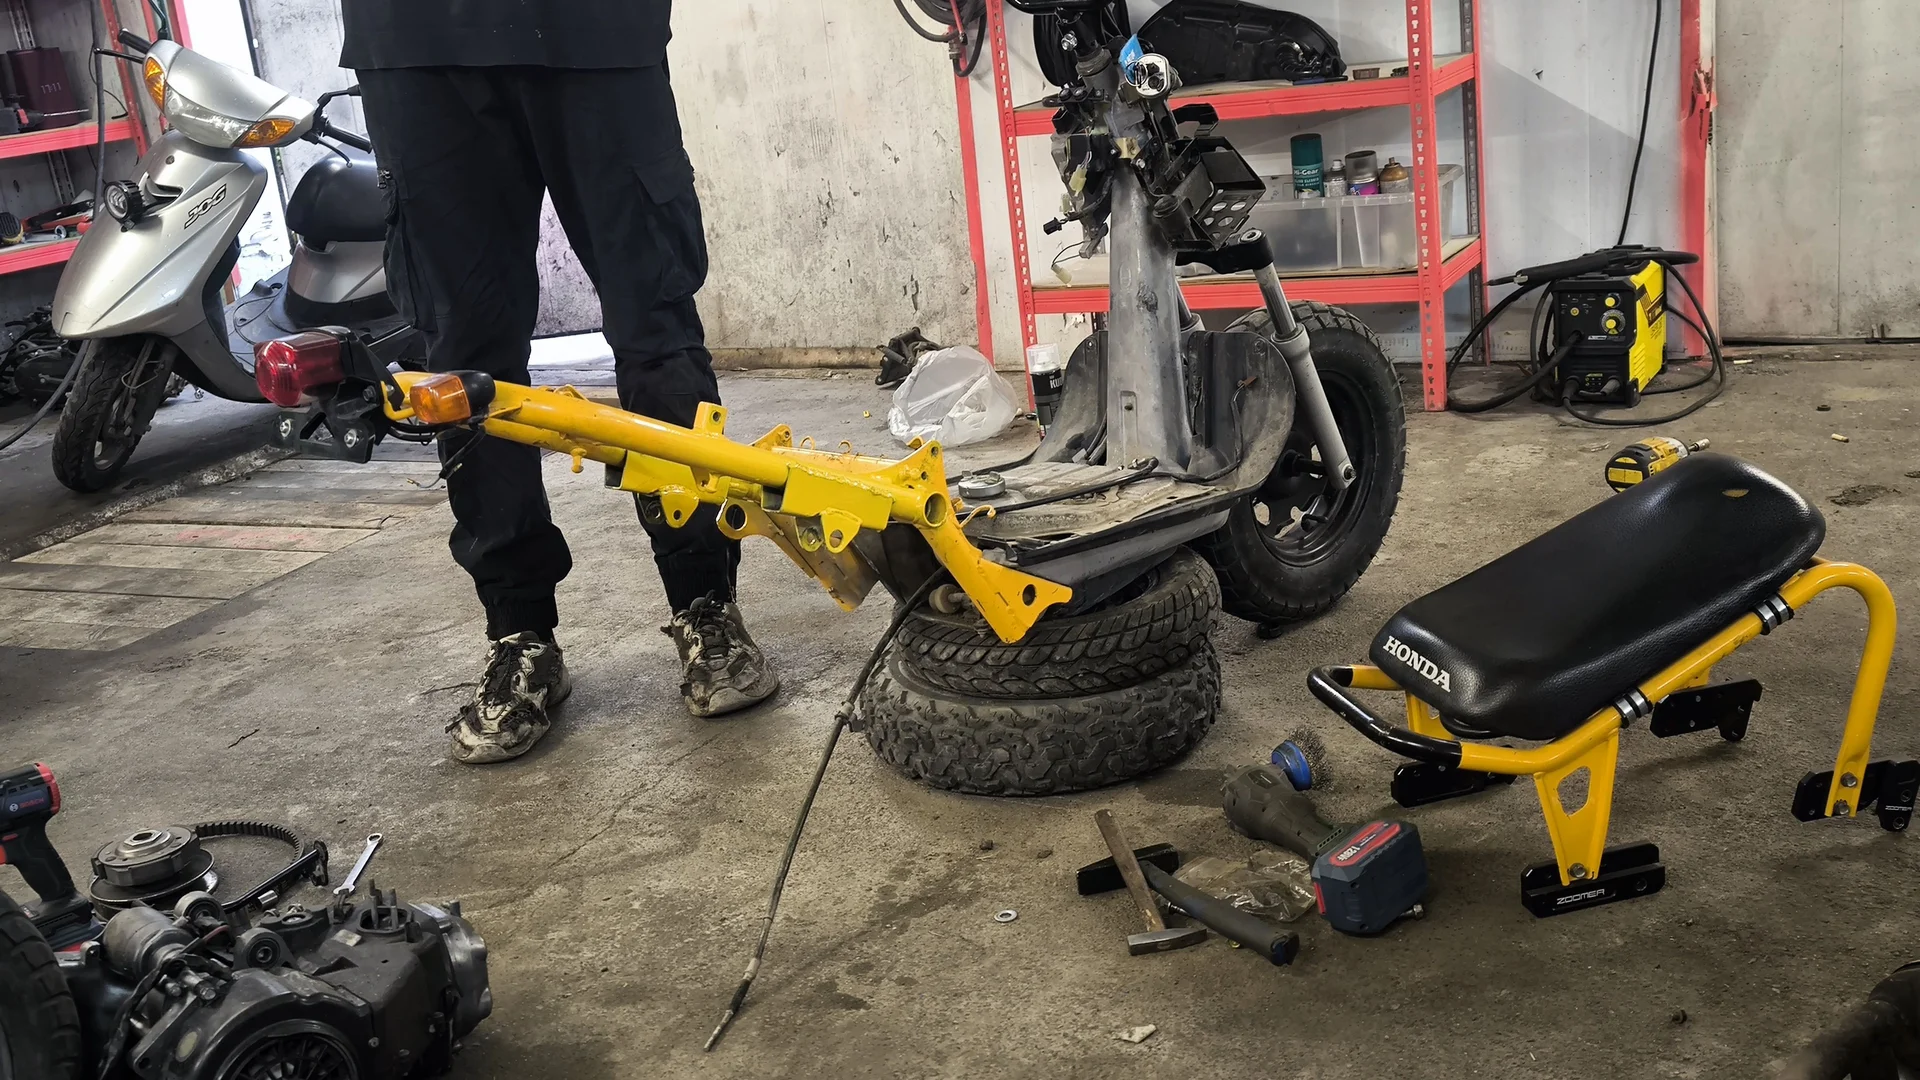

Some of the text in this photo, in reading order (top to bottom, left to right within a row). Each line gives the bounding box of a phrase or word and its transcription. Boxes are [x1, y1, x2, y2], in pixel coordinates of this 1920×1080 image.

[184, 183, 227, 230] JOG
[1382, 635, 1452, 693] HONDA
[1556, 888, 1605, 905] ZOOMER
